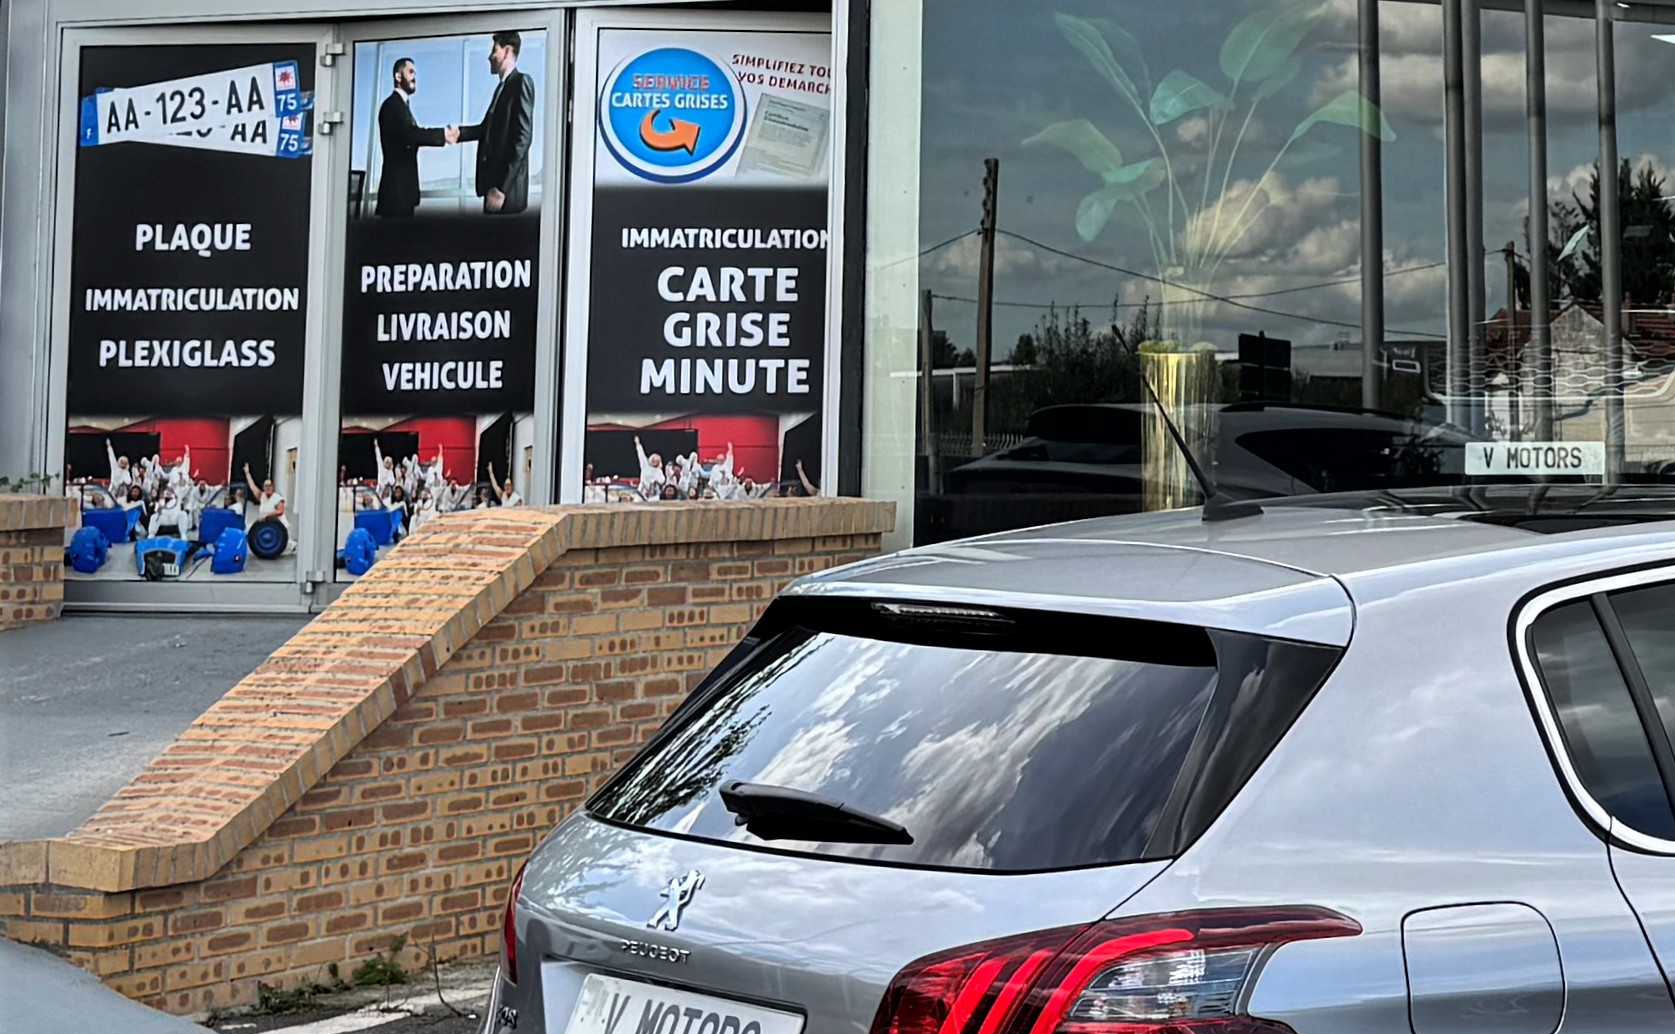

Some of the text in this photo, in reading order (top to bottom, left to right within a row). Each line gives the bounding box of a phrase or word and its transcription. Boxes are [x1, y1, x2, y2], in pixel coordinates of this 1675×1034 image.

[732, 54, 805, 75] SIMPLIFIEZ
[632, 74, 709, 90] SERVICE
[738, 71, 764, 85] VOS
[277, 93, 297, 111] 75
[611, 92, 729, 110] CARTES GRISES
[279, 133, 299, 152] 75
[135, 223, 252, 257] PLAQUE
[621, 227, 829, 250] IMMATRICULATION
[360, 259, 532, 294] PREPARATION
[656, 266, 800, 303] CARTE
[85, 287, 299, 311] IMMATRICULATION
[376, 310, 511, 342] LIVRAISON
[662, 312, 791, 348] GRISE
[98, 339, 276, 368] PLEXIGLASS
[382, 360, 504, 392] VEHICULE
[639, 358, 811, 395] MINUTE
[1482, 446, 1583, 469] V MOTORS
[620, 938, 691, 964] PEUGEOT
